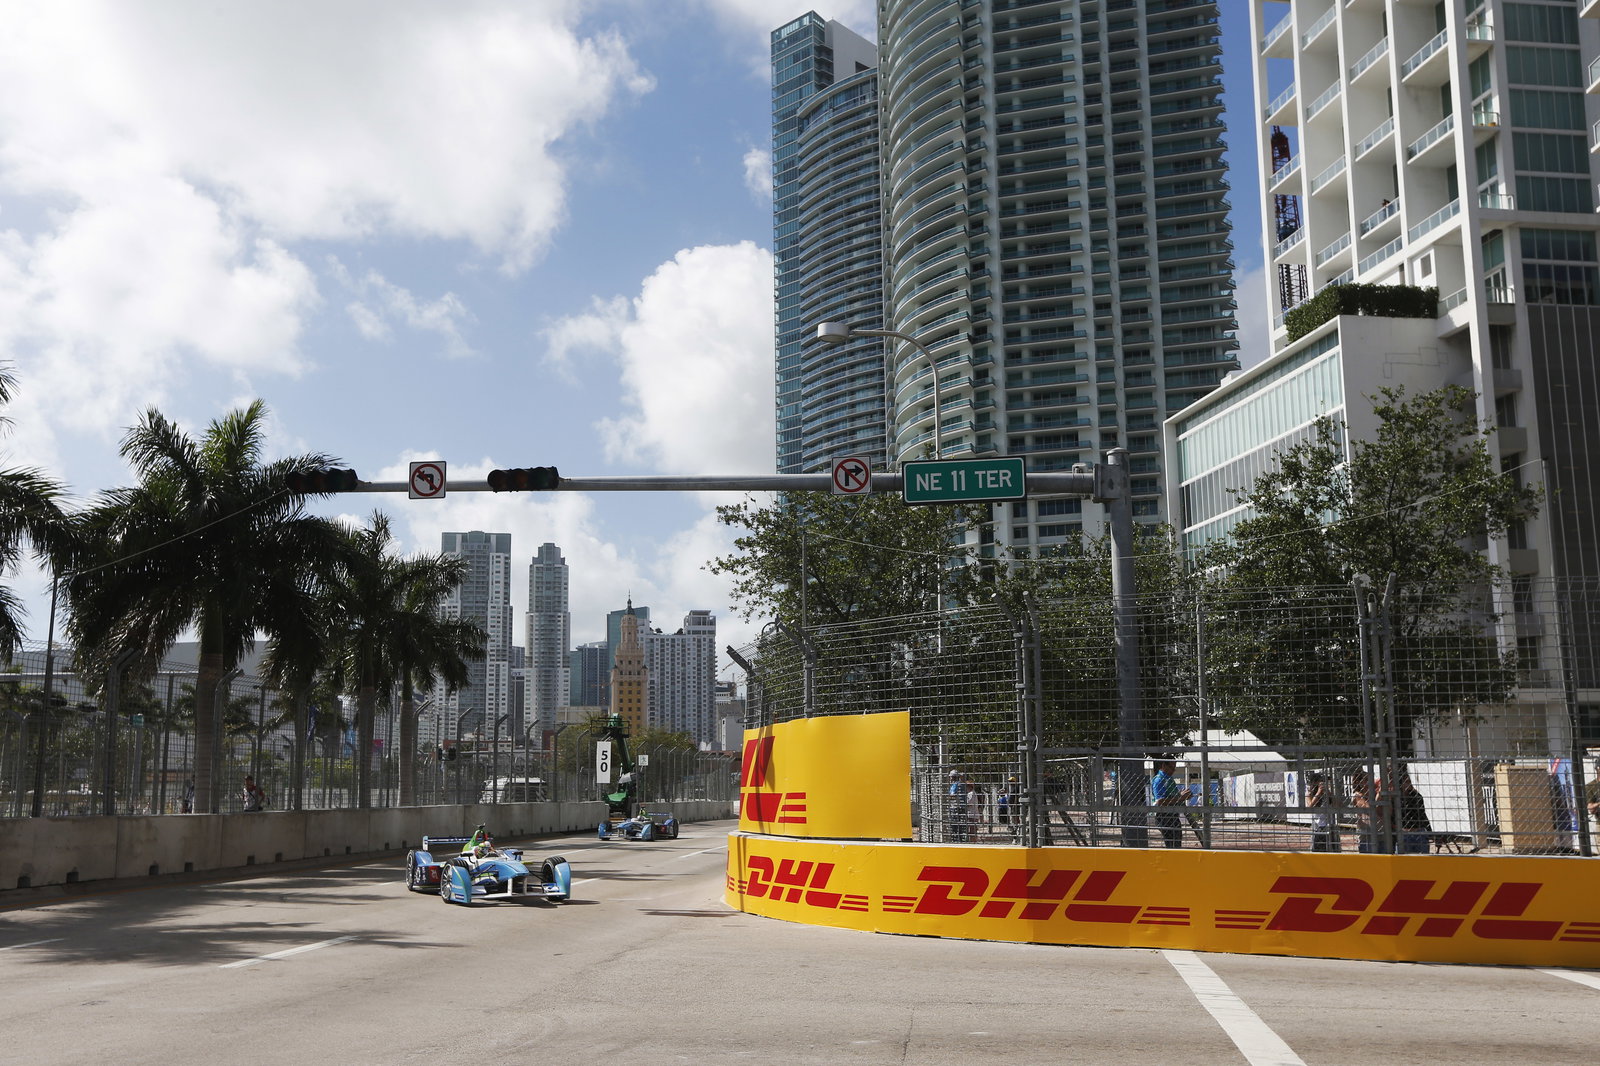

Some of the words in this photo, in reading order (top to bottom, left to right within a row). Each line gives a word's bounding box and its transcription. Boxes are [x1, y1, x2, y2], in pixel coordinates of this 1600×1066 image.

[916, 472, 942, 491] NE
[951, 470, 965, 491] 11
[974, 469, 1012, 488] TER
[600, 750, 608, 772] 50
[746, 855, 842, 909] DHL
[914, 866, 1142, 924] DHL
[1265, 876, 1564, 941] DHL
